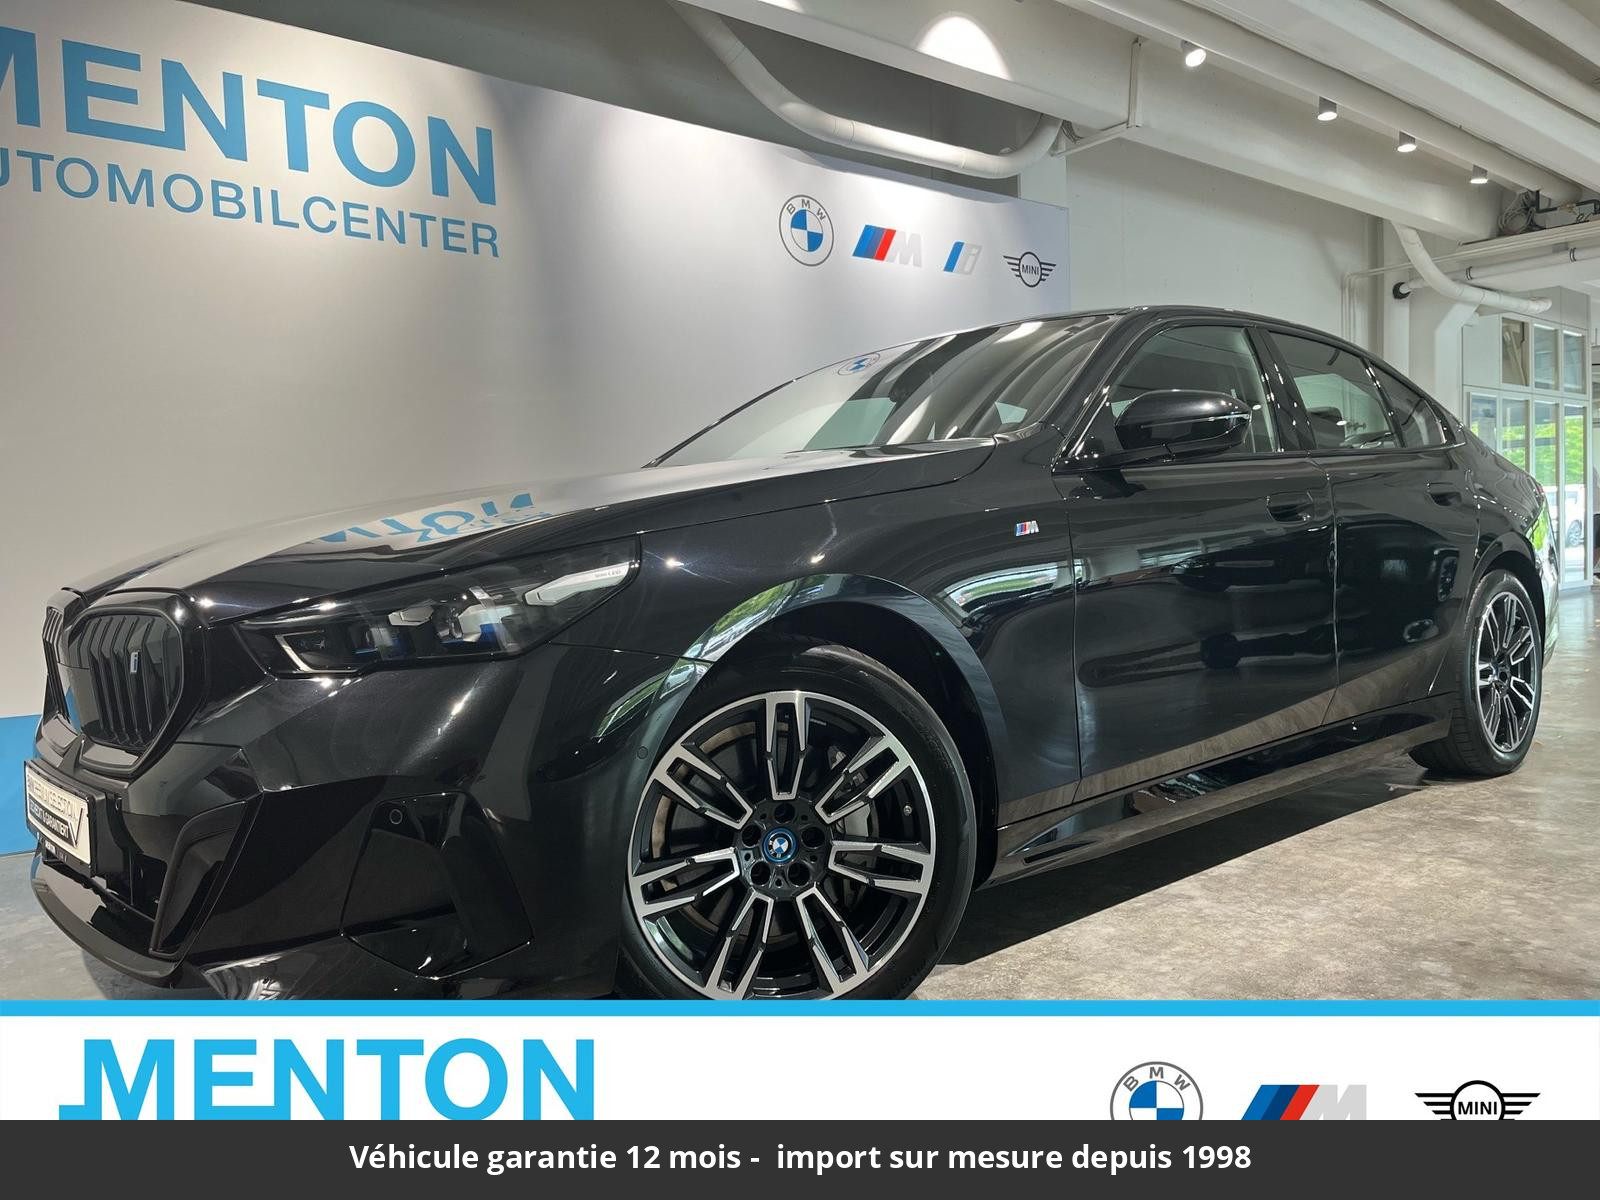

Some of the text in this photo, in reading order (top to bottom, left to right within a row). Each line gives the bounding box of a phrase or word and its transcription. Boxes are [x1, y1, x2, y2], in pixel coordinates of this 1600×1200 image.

[0, 147, 499, 257] TOMOBILCENTER
[786, 198, 827, 221] BMW
[1021, 264, 1040, 276] MINI
